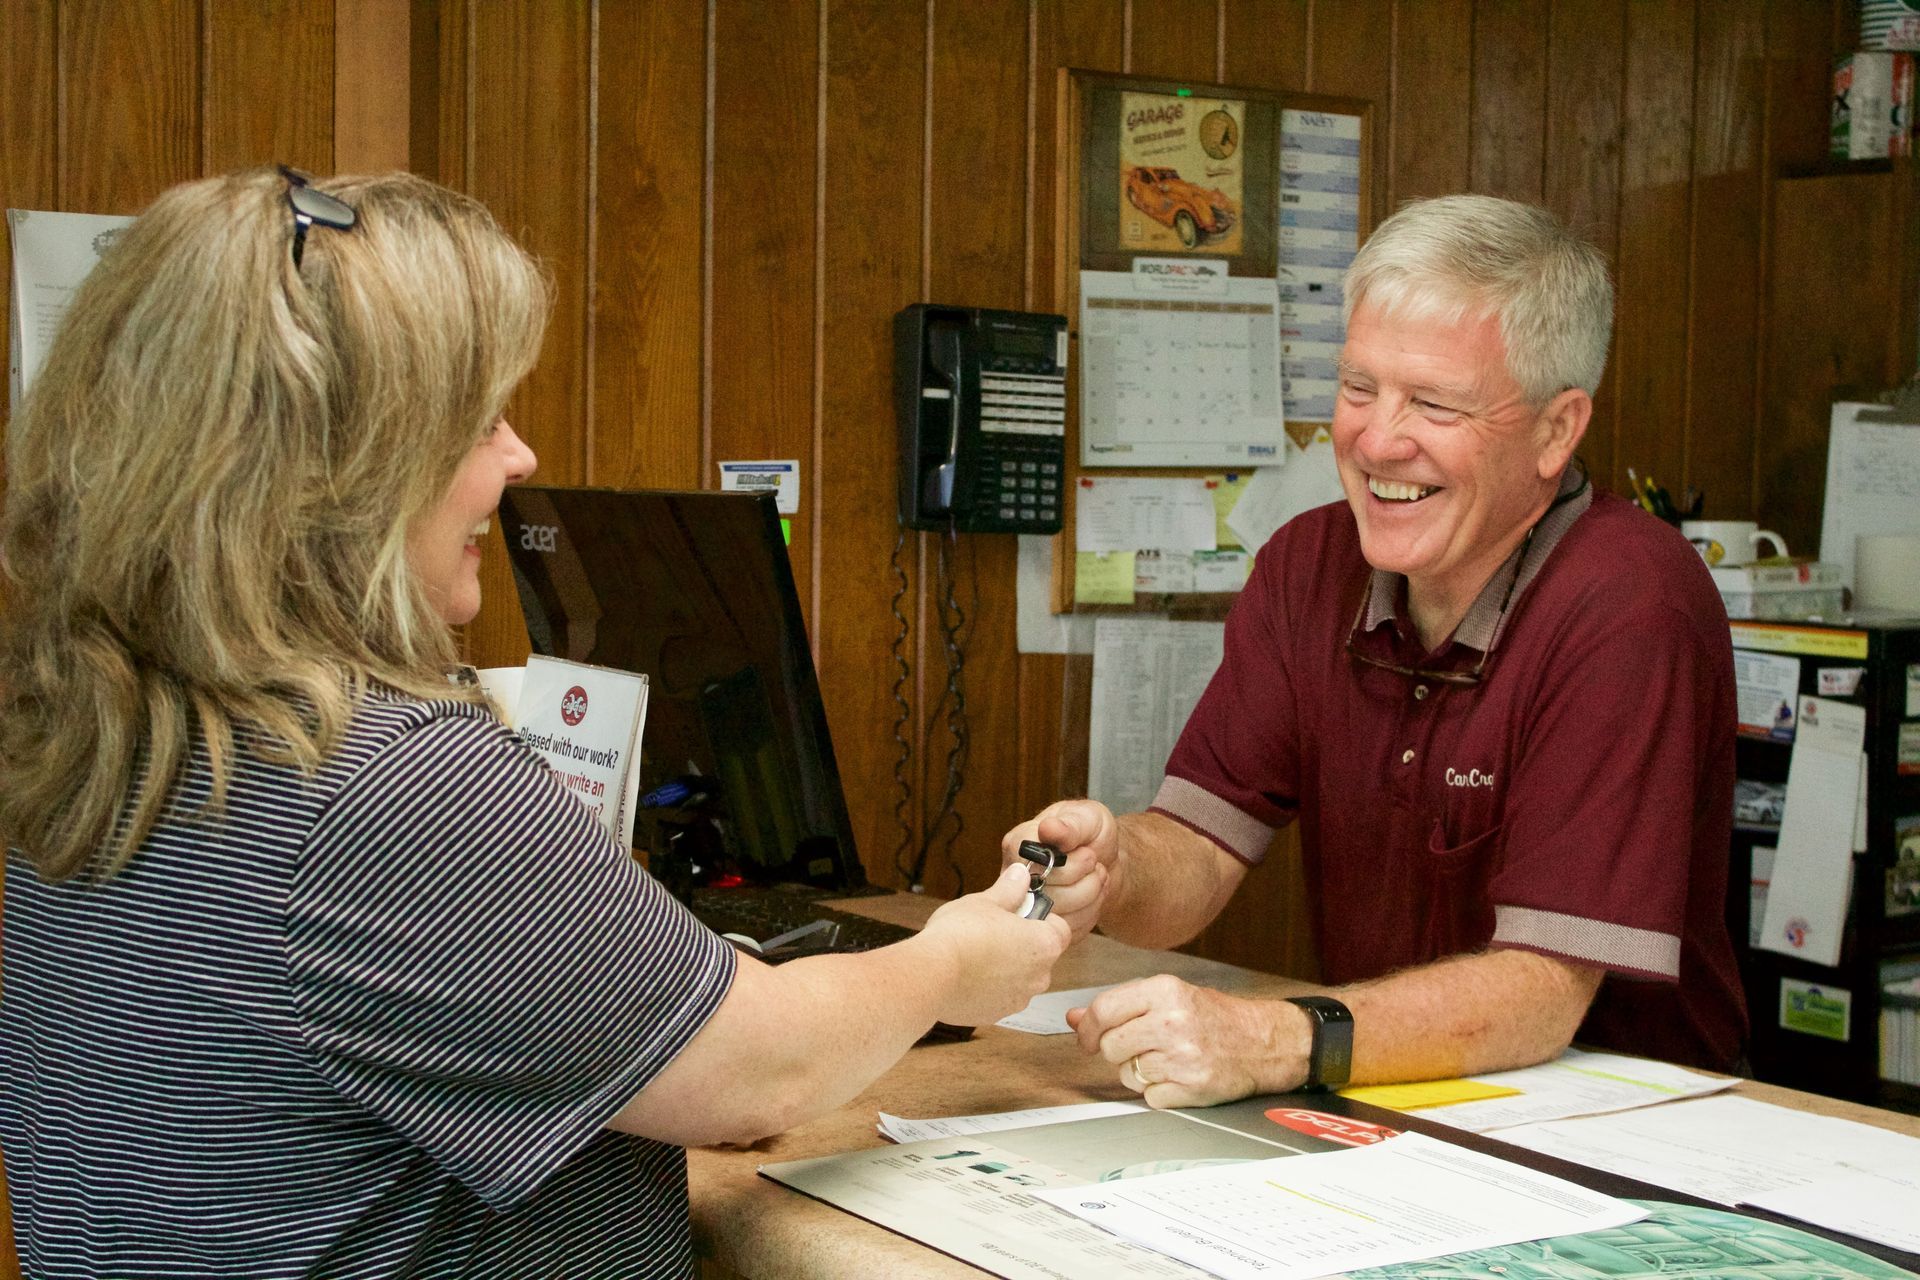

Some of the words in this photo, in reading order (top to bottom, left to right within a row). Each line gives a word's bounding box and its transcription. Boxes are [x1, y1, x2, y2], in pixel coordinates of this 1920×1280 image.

[1127, 104, 1184, 131] GARAGE
[519, 524, 559, 553] acer
[520, 726, 553, 752] Pleased
[552, 736, 573, 758] with
[572, 745, 590, 761] our
[590, 748, 619, 770] work?
[566, 771, 591, 794] write
[591, 780, 605, 798] an
